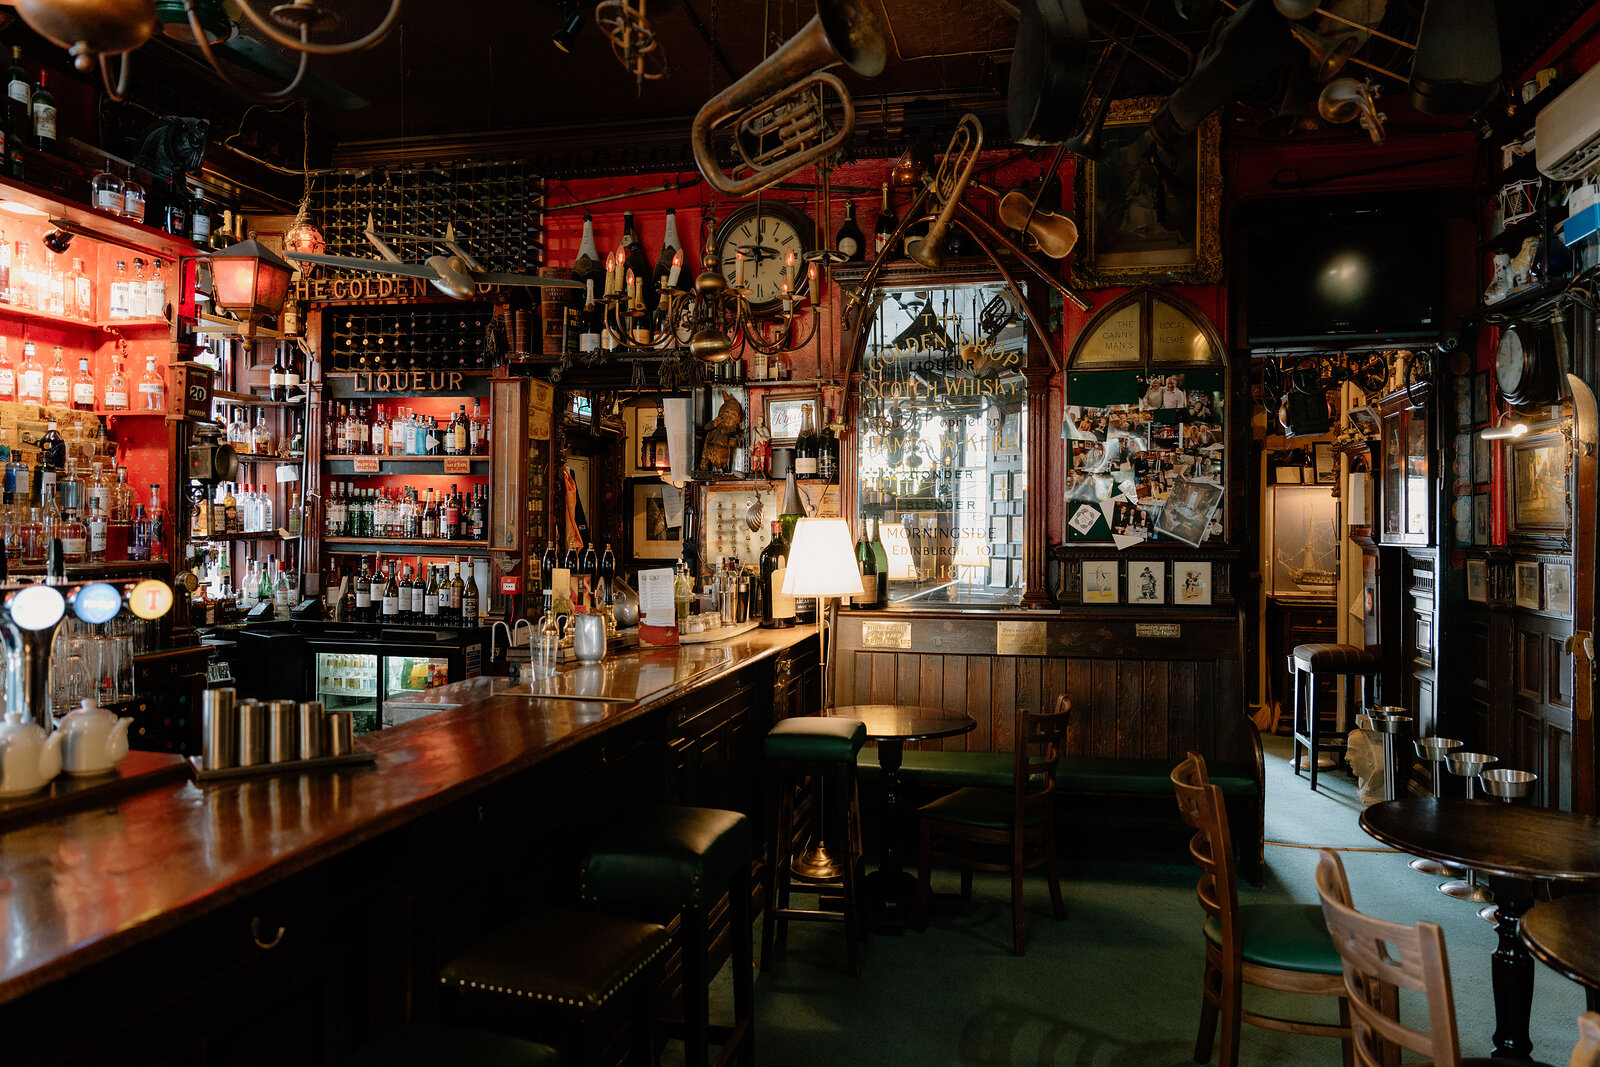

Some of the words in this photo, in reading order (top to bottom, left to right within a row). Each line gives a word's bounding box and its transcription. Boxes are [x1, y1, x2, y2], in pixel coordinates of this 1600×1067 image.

[296, 279, 328, 300] HE
[334, 277, 427, 299] GOLDEN
[921, 312, 962, 327] THE
[1118, 320, 1134, 328] THE
[1159, 321, 1187, 329] LOCAL
[1102, 331, 1134, 339] CANNY
[1159, 336, 1184, 344] NEWS
[868, 331, 948, 373] GOLDEN
[959, 332, 1019, 367] DROP
[909, 359, 975, 371] LIQUEUR
[354, 371, 464, 392] LIQUEUR
[868, 379, 938, 399] SCOTCH
[944, 377, 1020, 396] WHISKY
[190, 386, 205, 400] 20
[965, 432, 1017, 452] KERR
[906, 500, 976, 510] BLENDER
[887, 527, 997, 539] MORNINGSIDE
[976, 545, 991, 556] 10
[146, 589, 161, 610] T
